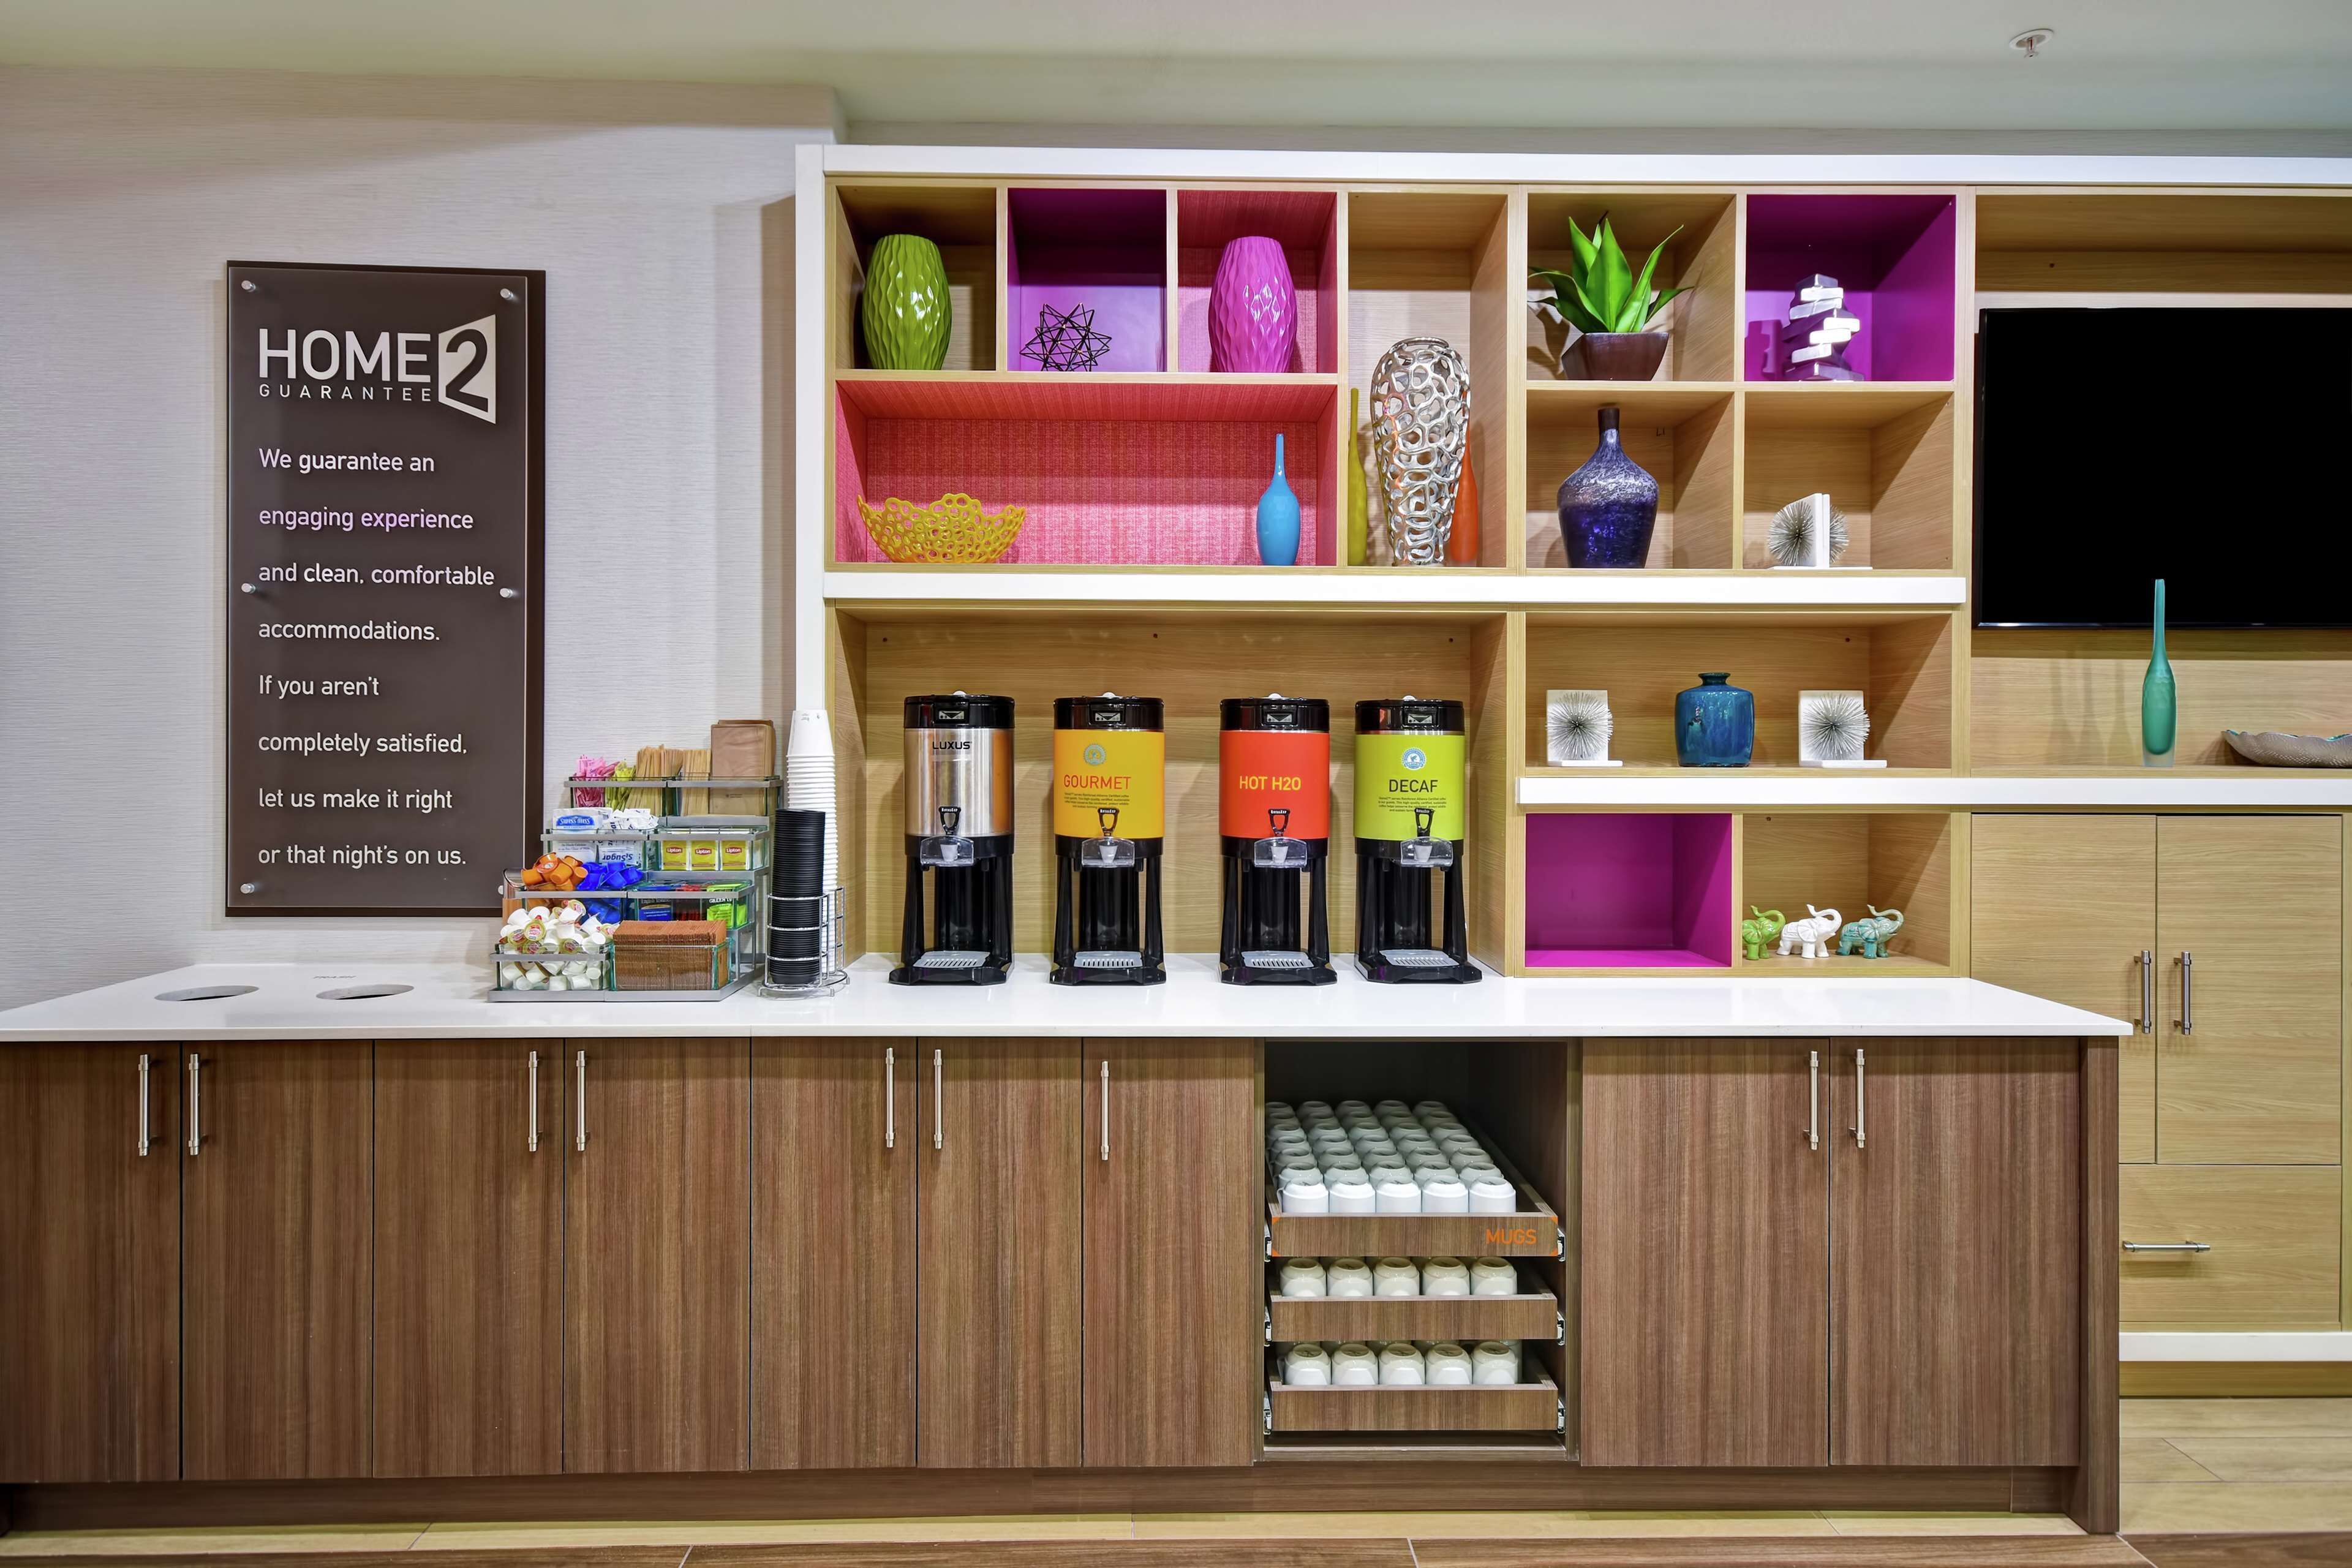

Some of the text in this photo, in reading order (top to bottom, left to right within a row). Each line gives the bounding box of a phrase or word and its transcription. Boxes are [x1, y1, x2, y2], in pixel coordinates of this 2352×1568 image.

[259, 328, 431, 383] HOME
[260, 383, 431, 402] GUARANTEE
[258, 448, 435, 475] We guarantee an
[259, 506, 474, 532] engaging experience
[258, 562, 495, 586] and clean, comfortable
[258, 620, 440, 641] accommodations.
[259, 674, 380, 699] If you aren't
[258, 732, 467, 757] completely satisfied,
[932, 741, 970, 750] LUXUS
[1064, 774, 1131, 790] GOURMET
[1239, 775, 1268, 790] HOT
[1389, 779, 1438, 793] DECAF
[259, 788, 453, 813] let us make it right
[258, 844, 467, 869] or that night's on us.
[602, 853, 626, 862] Sugar
[1486, 1229, 1536, 1245] MUGS
